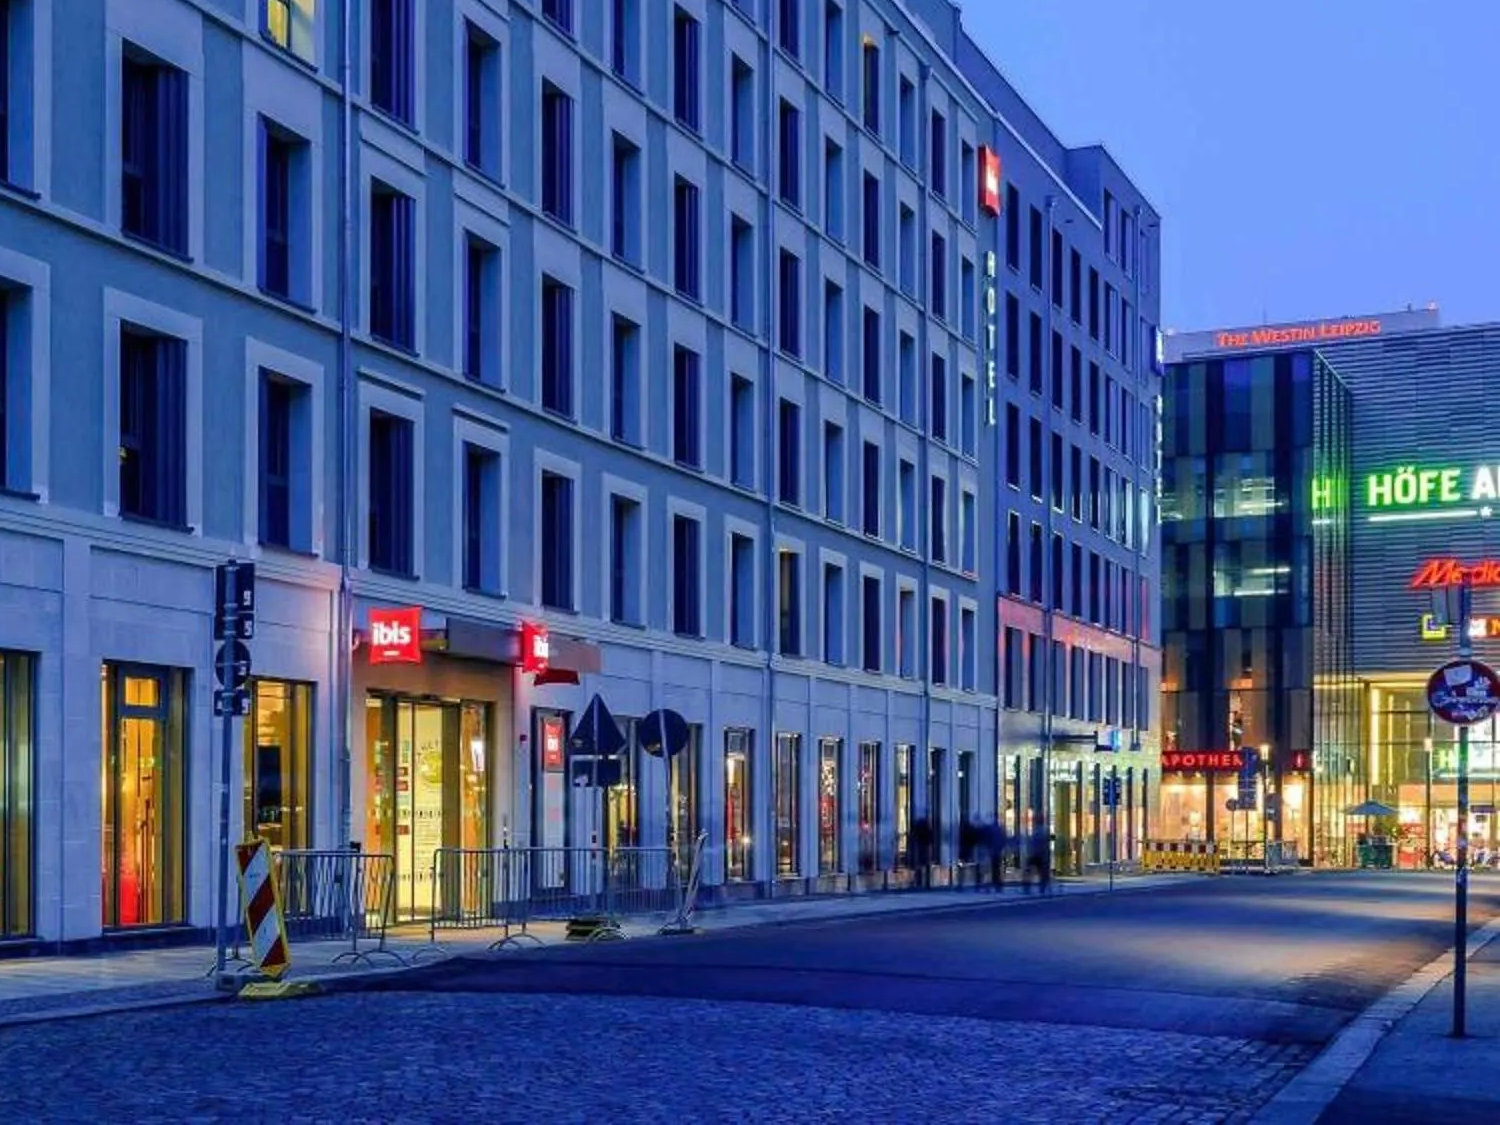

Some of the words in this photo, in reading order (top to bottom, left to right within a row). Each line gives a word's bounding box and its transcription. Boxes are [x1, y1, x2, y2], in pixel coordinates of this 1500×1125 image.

[987, 250, 996, 425] HOTEL
[1252, 326, 1315, 344] WESTIN
[1320, 320, 1381, 338] LEIPZIG
[1367, 465, 1461, 506] HÖFE
[1471, 465, 1500, 500] A
[372, 620, 411, 645] ibis
[533, 633, 548, 658] ibi
[1160, 753, 1243, 766] APOTHEK
